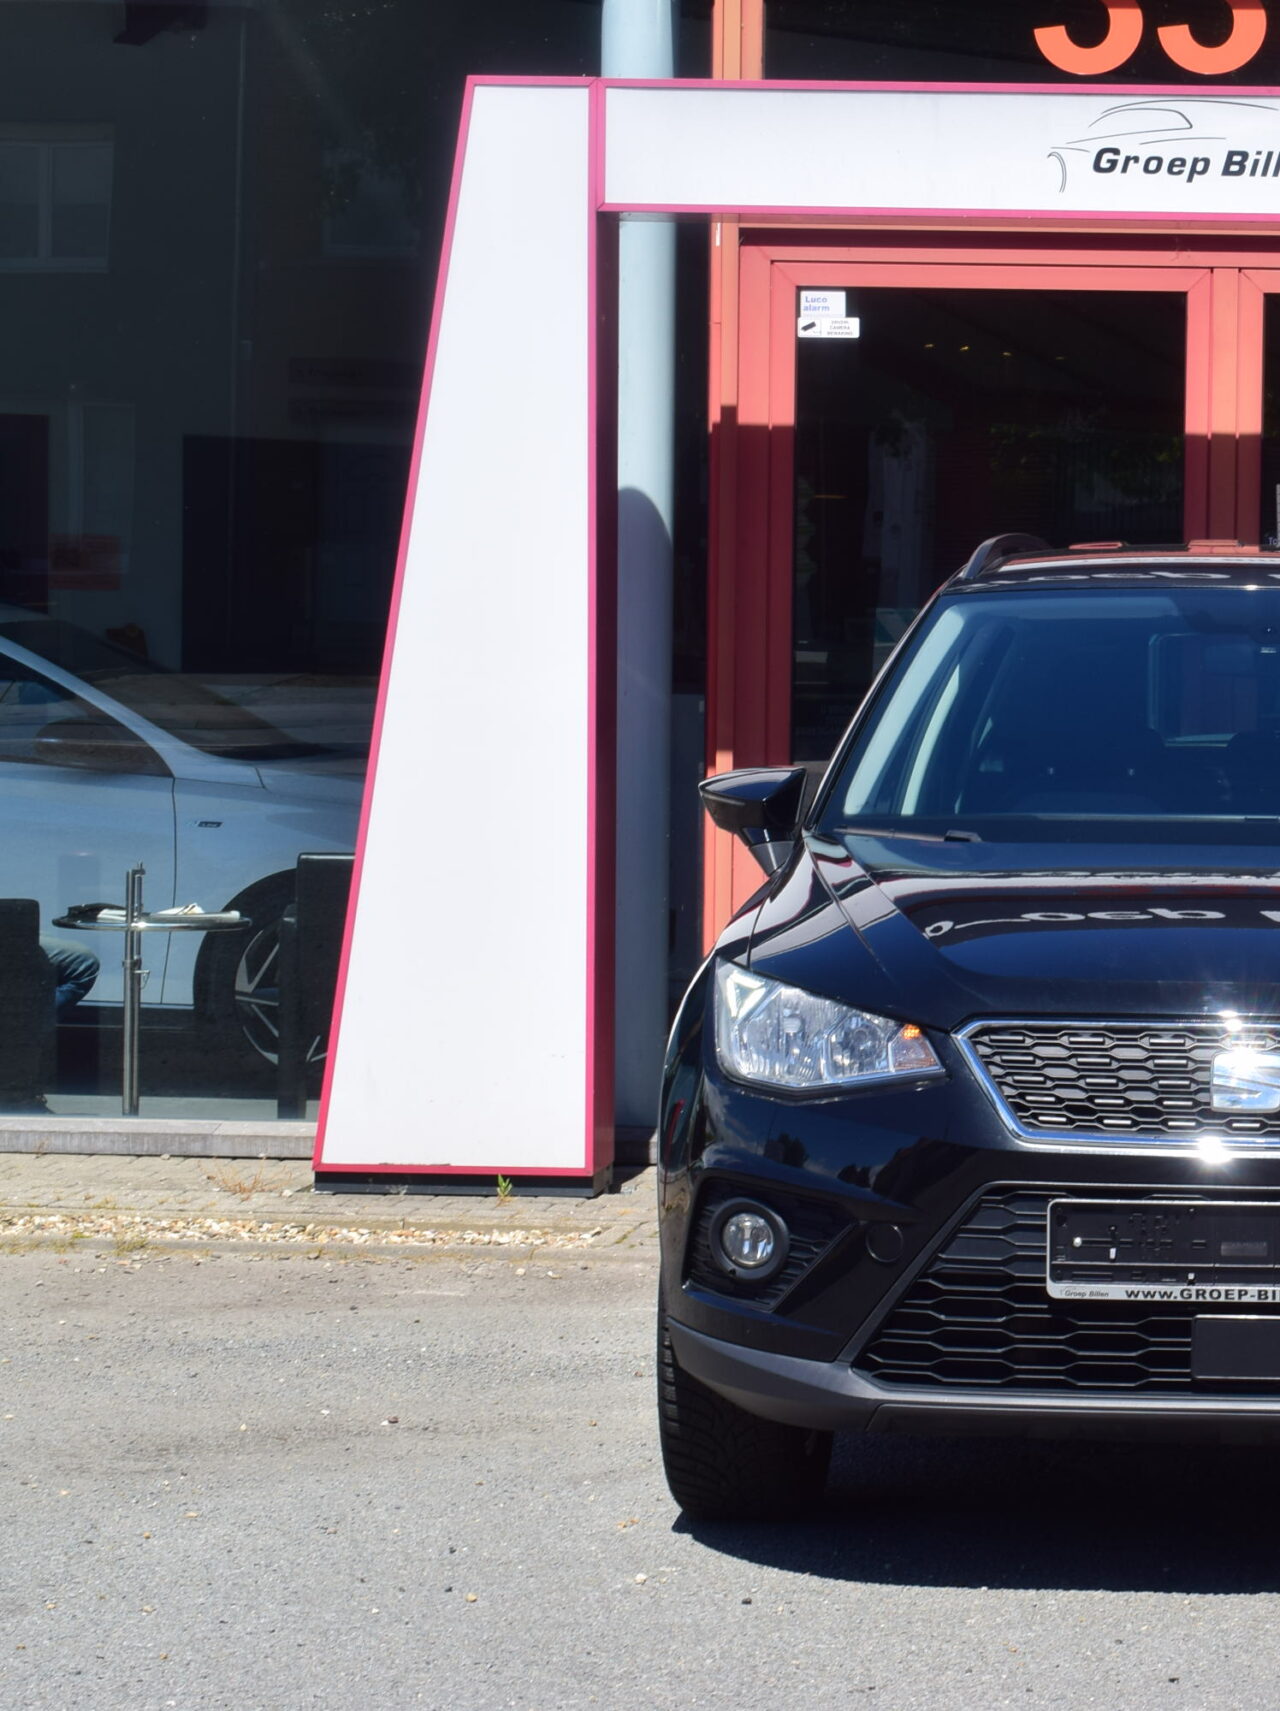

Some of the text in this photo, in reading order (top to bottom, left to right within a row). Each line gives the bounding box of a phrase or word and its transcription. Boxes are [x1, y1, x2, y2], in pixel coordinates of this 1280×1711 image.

[1092, 147, 1210, 183] Groep
[805, 296, 828, 304] Luco
[803, 304, 830, 312] alarm
[1064, 1289, 1087, 1298] Groep
